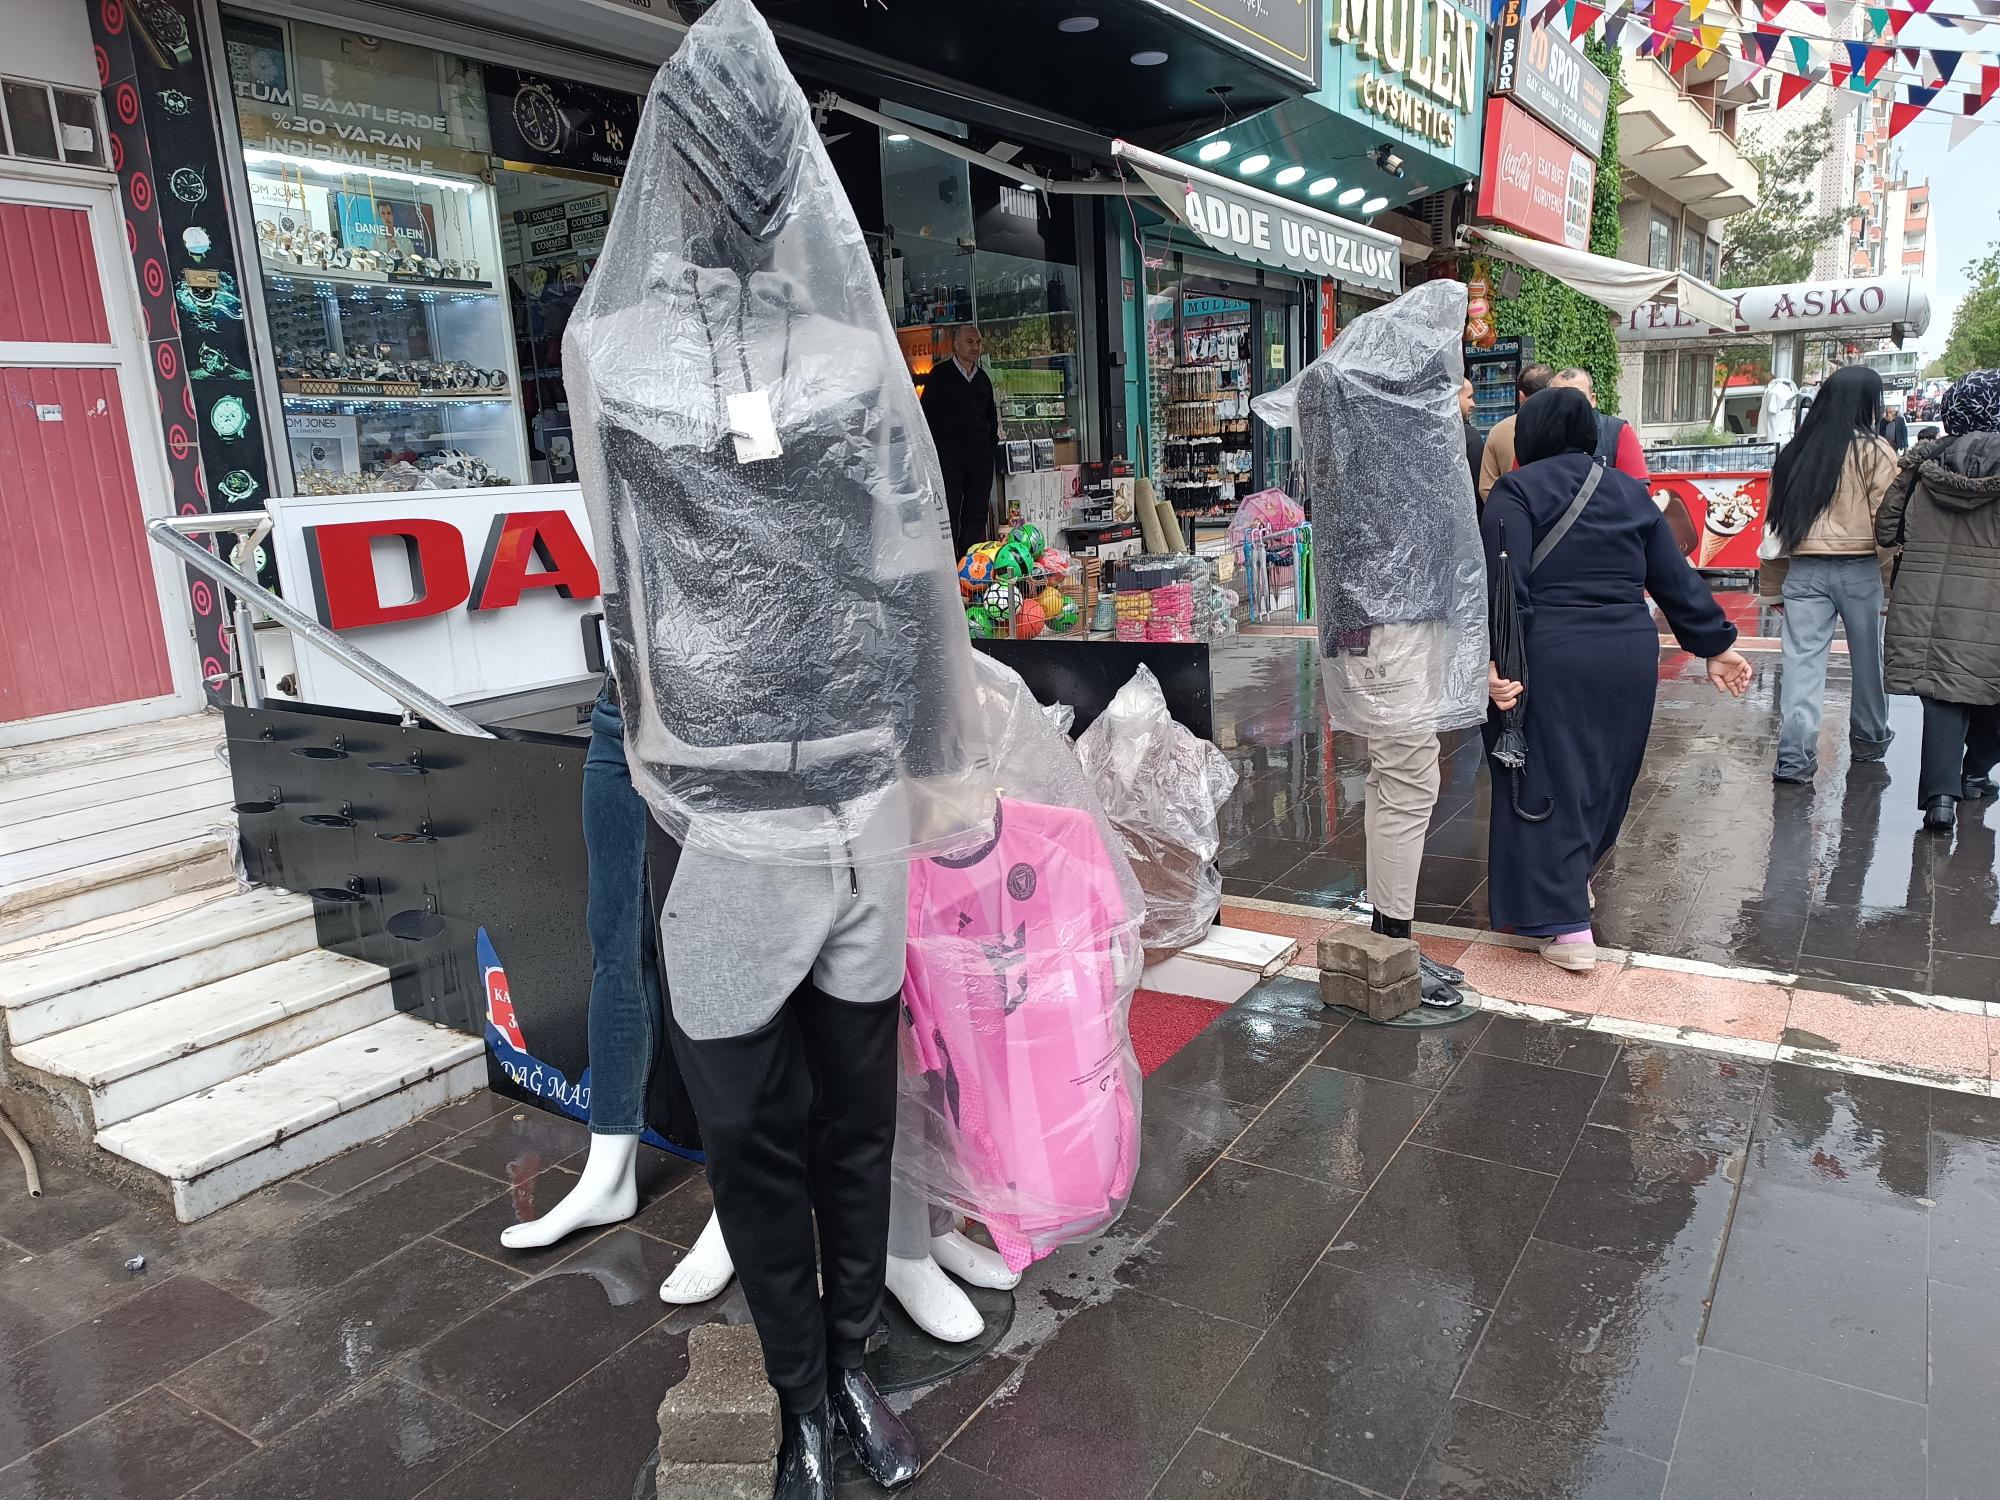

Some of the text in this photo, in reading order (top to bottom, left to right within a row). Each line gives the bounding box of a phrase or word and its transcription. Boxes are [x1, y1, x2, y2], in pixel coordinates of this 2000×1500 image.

[1330, 0, 1479, 114] MULEN
[1499, 0, 1519, 89] FD SPOR
[1548, 42, 1580, 103] SPOR
[233, 80, 447, 132] TÜM SAATLERDE
[1359, 72, 1456, 148] COSMETICS
[272, 112, 421, 150] %30 VARAN
[1537, 156, 1552, 180] ESAT
[272, 186, 306, 199] JONES
[999, 185, 1038, 220] PUMA
[355, 222, 423, 240] DANIEL KLEIN
[1185, 191, 1394, 281] ADDE UCUZLUK
[1187, 299, 1243, 313] MULEN
[1769, 286, 1887, 320] ASKO
[342, 383, 382, 394] RAYMOND
[306, 419, 336, 428] JONES
[508, 1012, 519, 1029] 3
[500, 1061, 543, 1096] DAĞ
